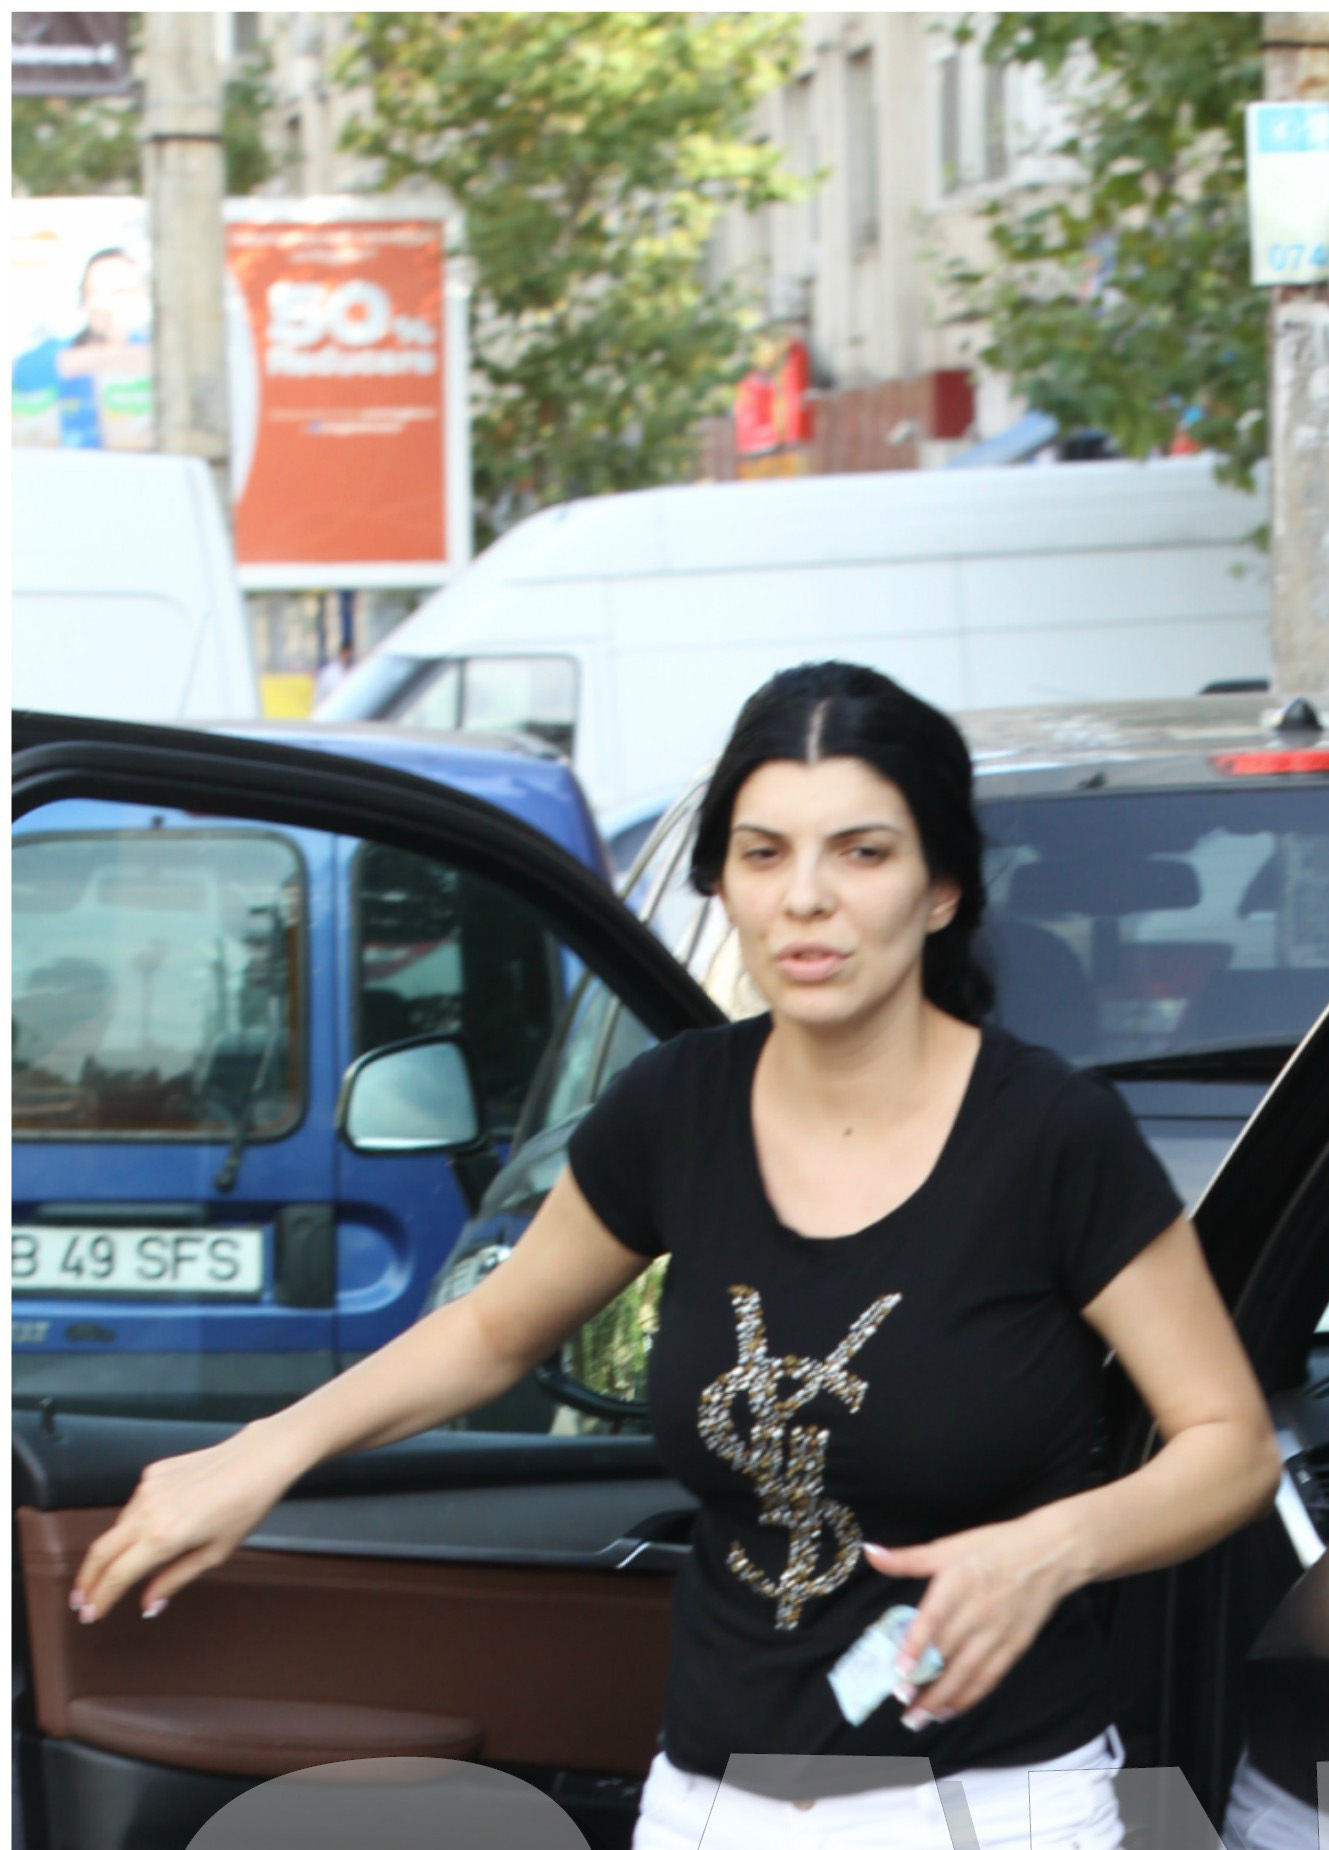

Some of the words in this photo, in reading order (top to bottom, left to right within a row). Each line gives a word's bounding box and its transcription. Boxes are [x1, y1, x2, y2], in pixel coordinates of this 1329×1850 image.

[12, 1234, 39, 1278] B
[60, 1234, 115, 1280] 49
[137, 1235, 241, 1282] SFS
